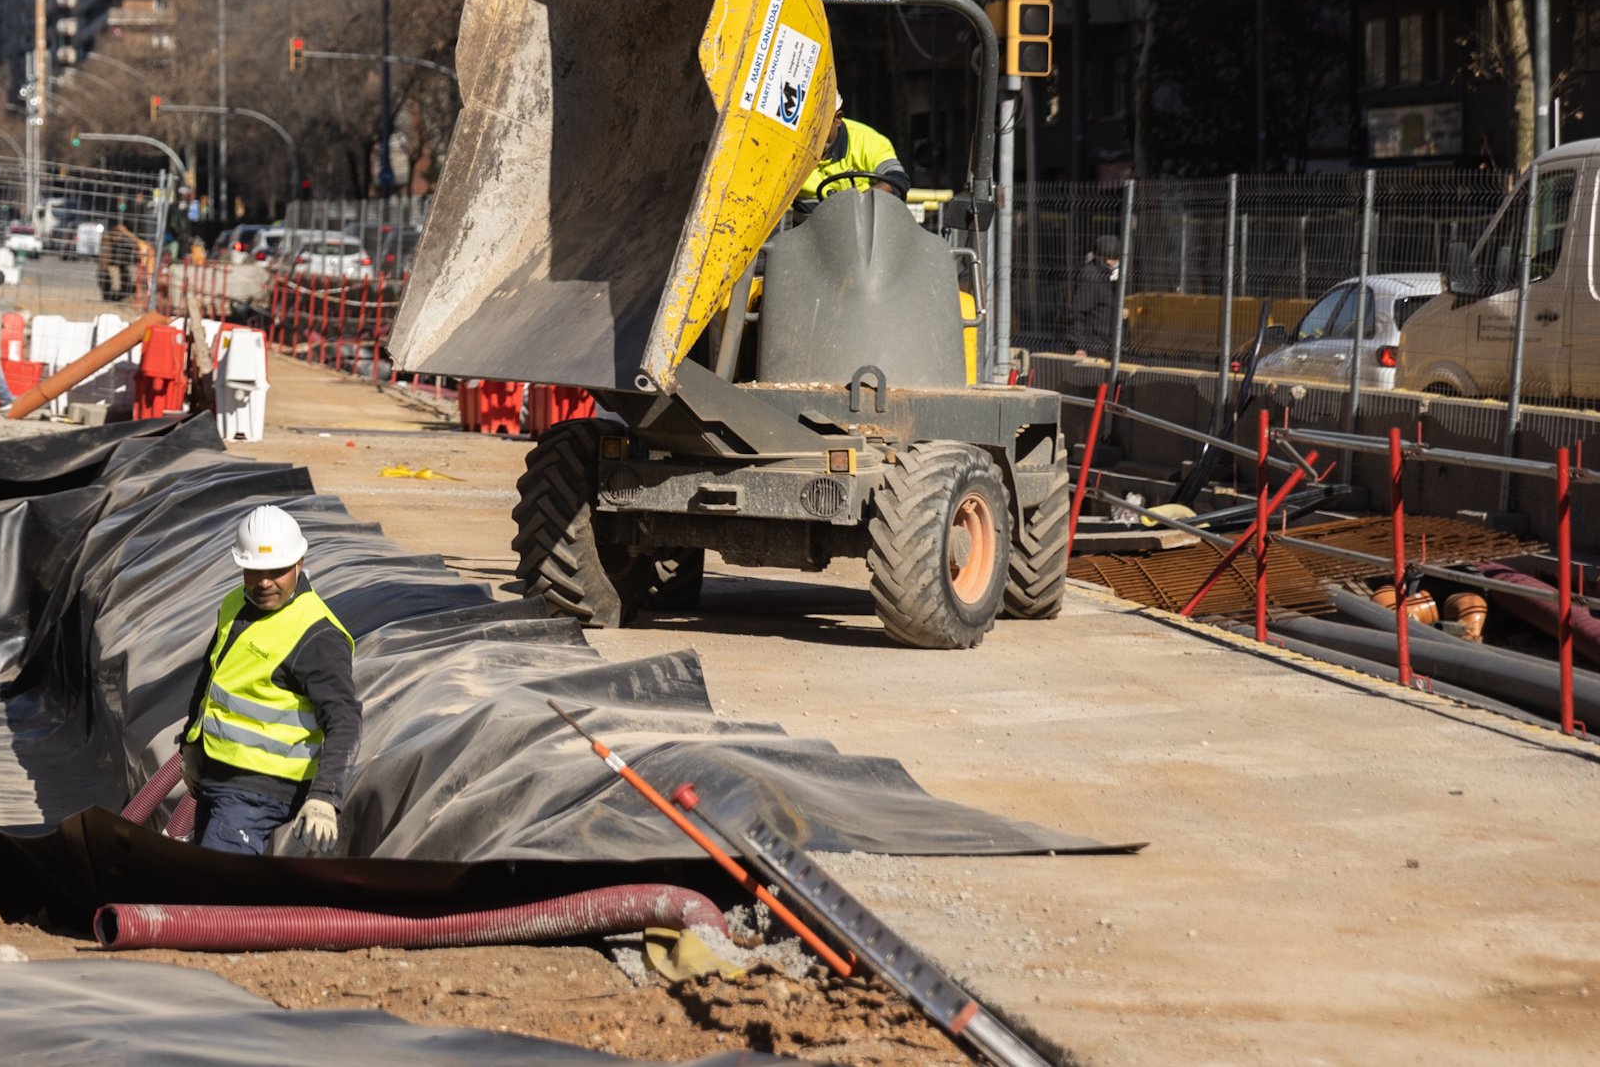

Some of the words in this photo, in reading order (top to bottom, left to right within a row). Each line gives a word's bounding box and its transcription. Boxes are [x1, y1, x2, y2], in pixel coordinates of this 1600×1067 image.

[751, 50, 765, 83] MARTÍ
[760, 3, 780, 51] CANUDAS
[761, 80, 771, 109] MARTÍ
[768, 39, 784, 81] CANUDAS
